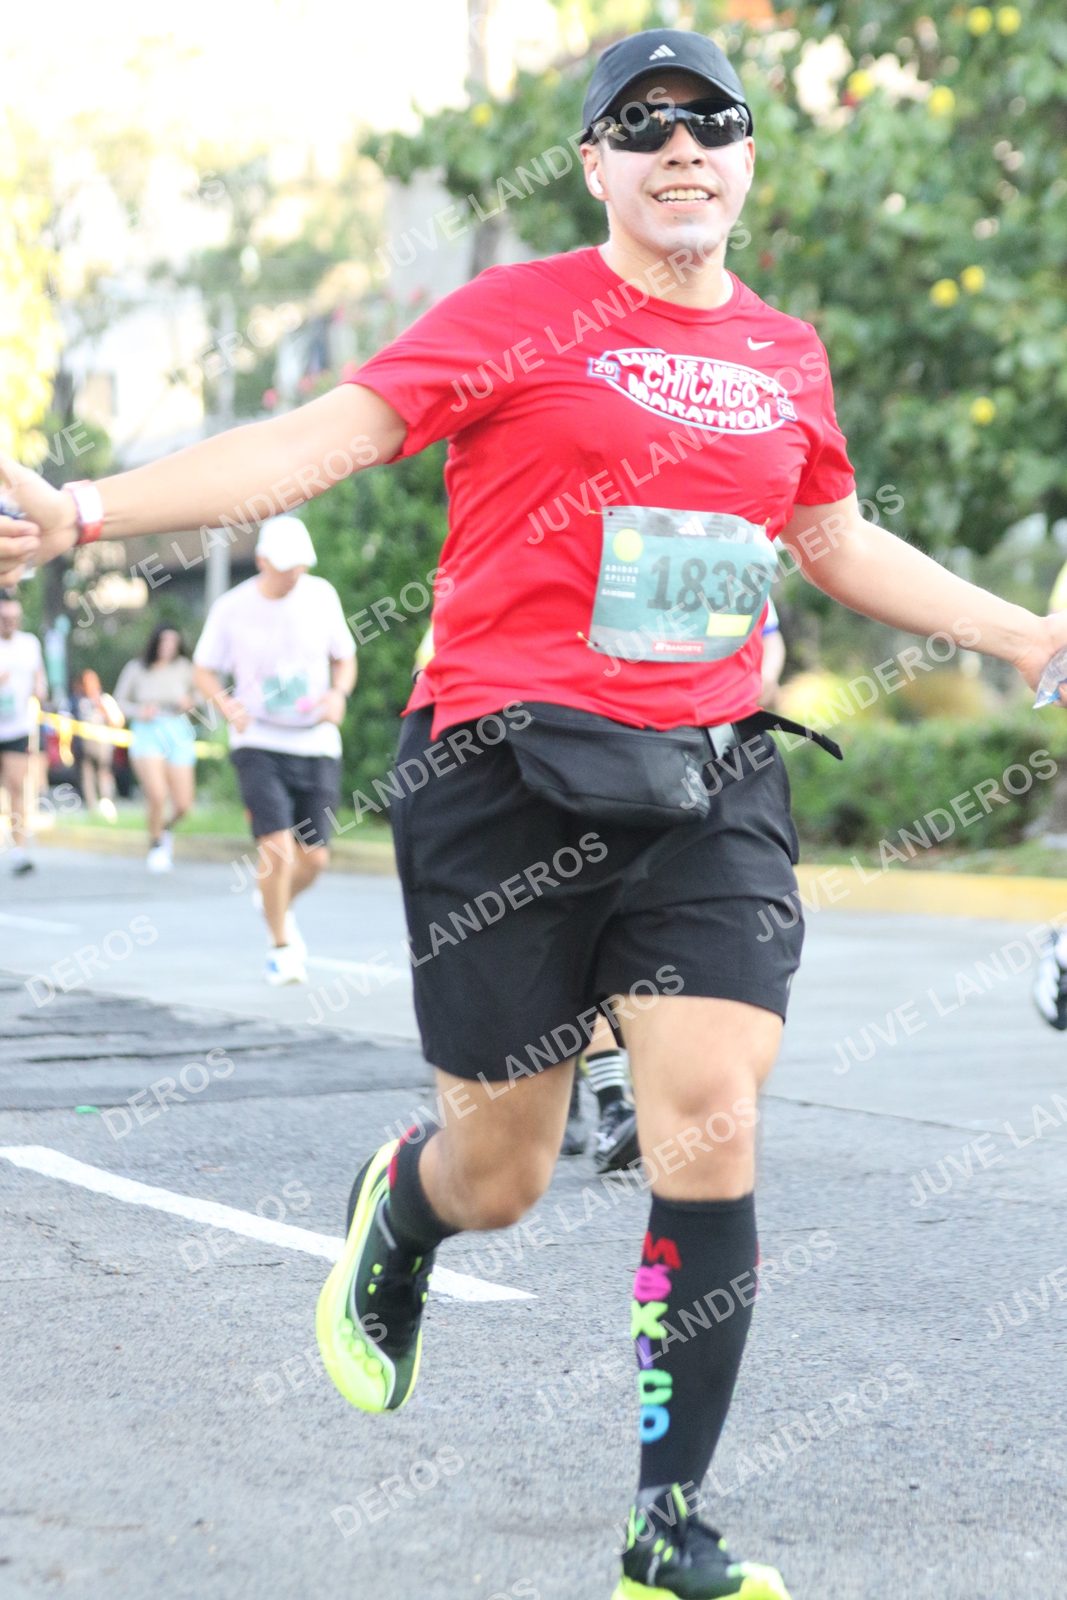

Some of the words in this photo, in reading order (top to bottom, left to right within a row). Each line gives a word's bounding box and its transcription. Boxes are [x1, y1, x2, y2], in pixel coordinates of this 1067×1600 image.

[594, 360, 615, 375] 20
[642, 363, 760, 409] CHICAGO
[627, 372, 772, 429] MARATHON
